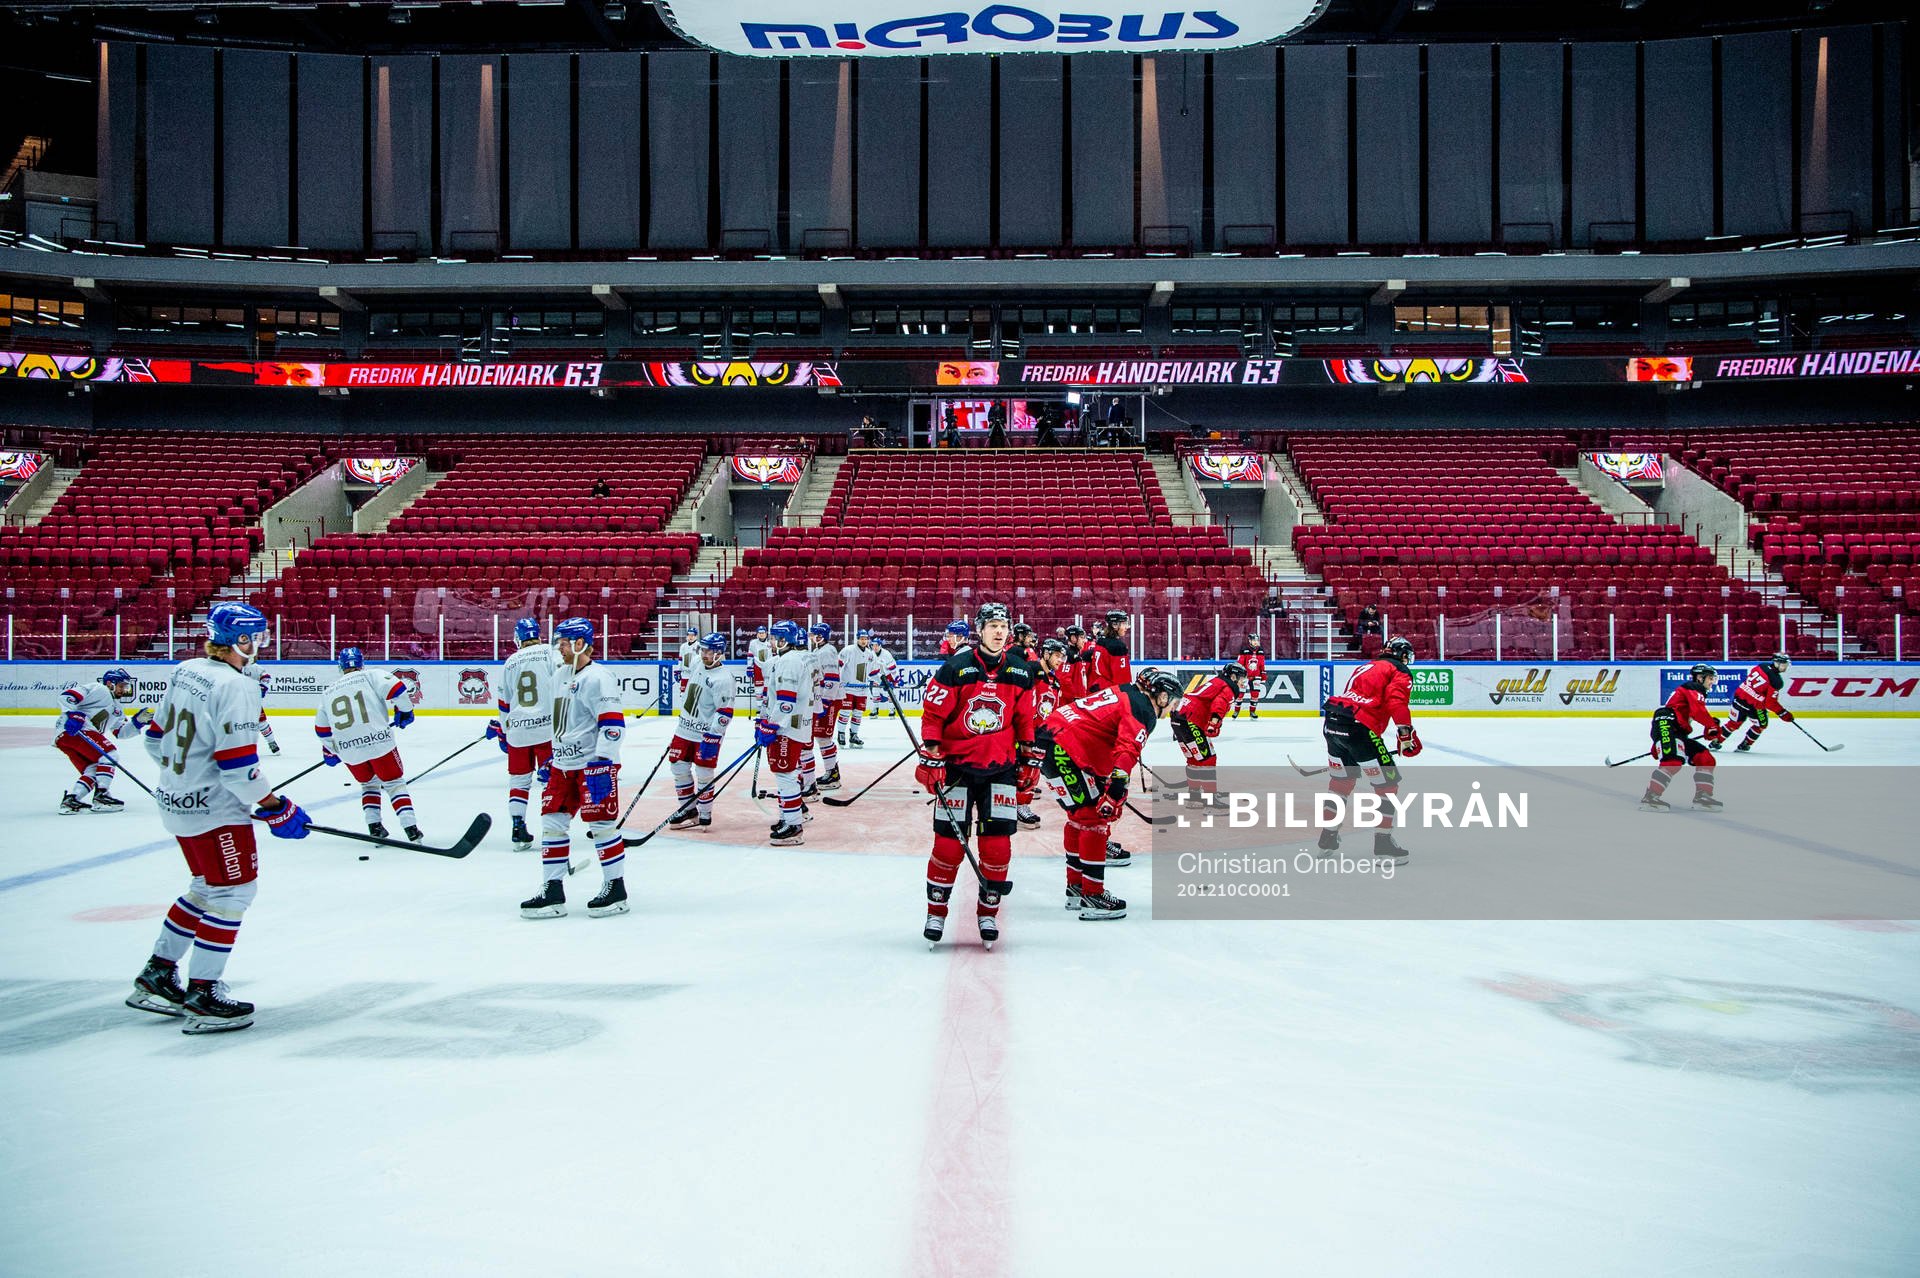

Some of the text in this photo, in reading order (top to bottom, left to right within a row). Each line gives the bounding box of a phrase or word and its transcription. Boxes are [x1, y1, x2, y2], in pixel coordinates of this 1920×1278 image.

[347, 363, 603, 387] FREDRIK HÄNDEMARK 63
[1021, 360, 1283, 385] FREDRIK HÄNDEMARK 63
[1716, 357, 1798, 377] FREDRIK
[139, 682, 167, 691] NORD
[275, 676, 316, 684] MALMÖ
[1489, 668, 1551, 705] guld
[1559, 668, 1621, 705] guld
[1667, 672, 1685, 681] Fait
[1746, 671, 1767, 689] 27
[1787, 678, 1920, 697] CCM
[517, 671, 538, 707] 8
[926, 685, 948, 705] 22
[332, 690, 370, 730] 91
[338, 729, 391, 750] formakök
[1659, 720, 1671, 743] akea
[1369, 730, 1390, 764] akea
